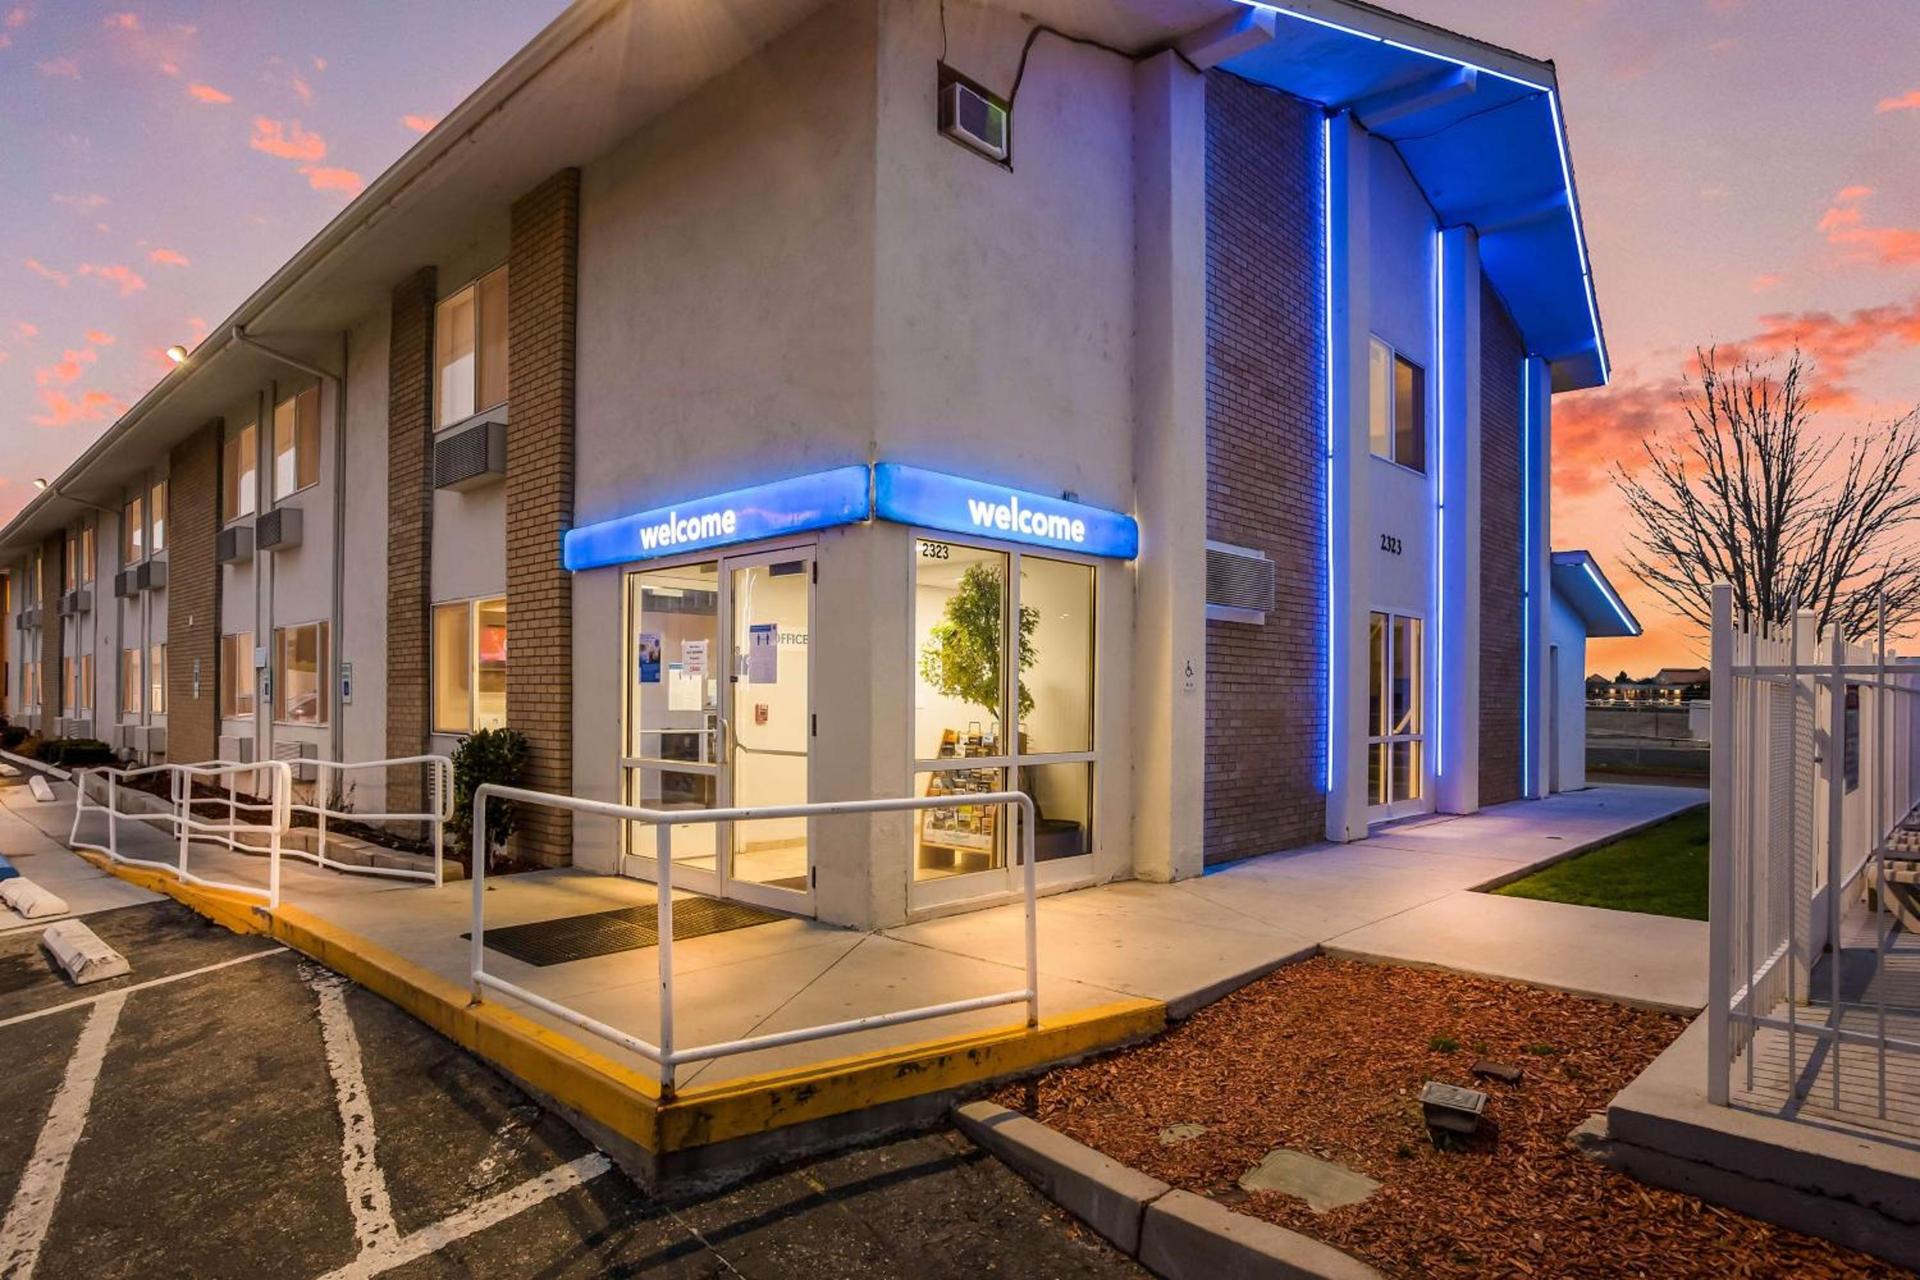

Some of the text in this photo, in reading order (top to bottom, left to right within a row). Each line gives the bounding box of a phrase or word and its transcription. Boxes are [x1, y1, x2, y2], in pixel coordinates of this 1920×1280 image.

[640, 509, 737, 550] welcome
[968, 495, 1086, 543] welcome
[922, 542, 950, 560] 2323
[1380, 533, 1402, 556] 2323
